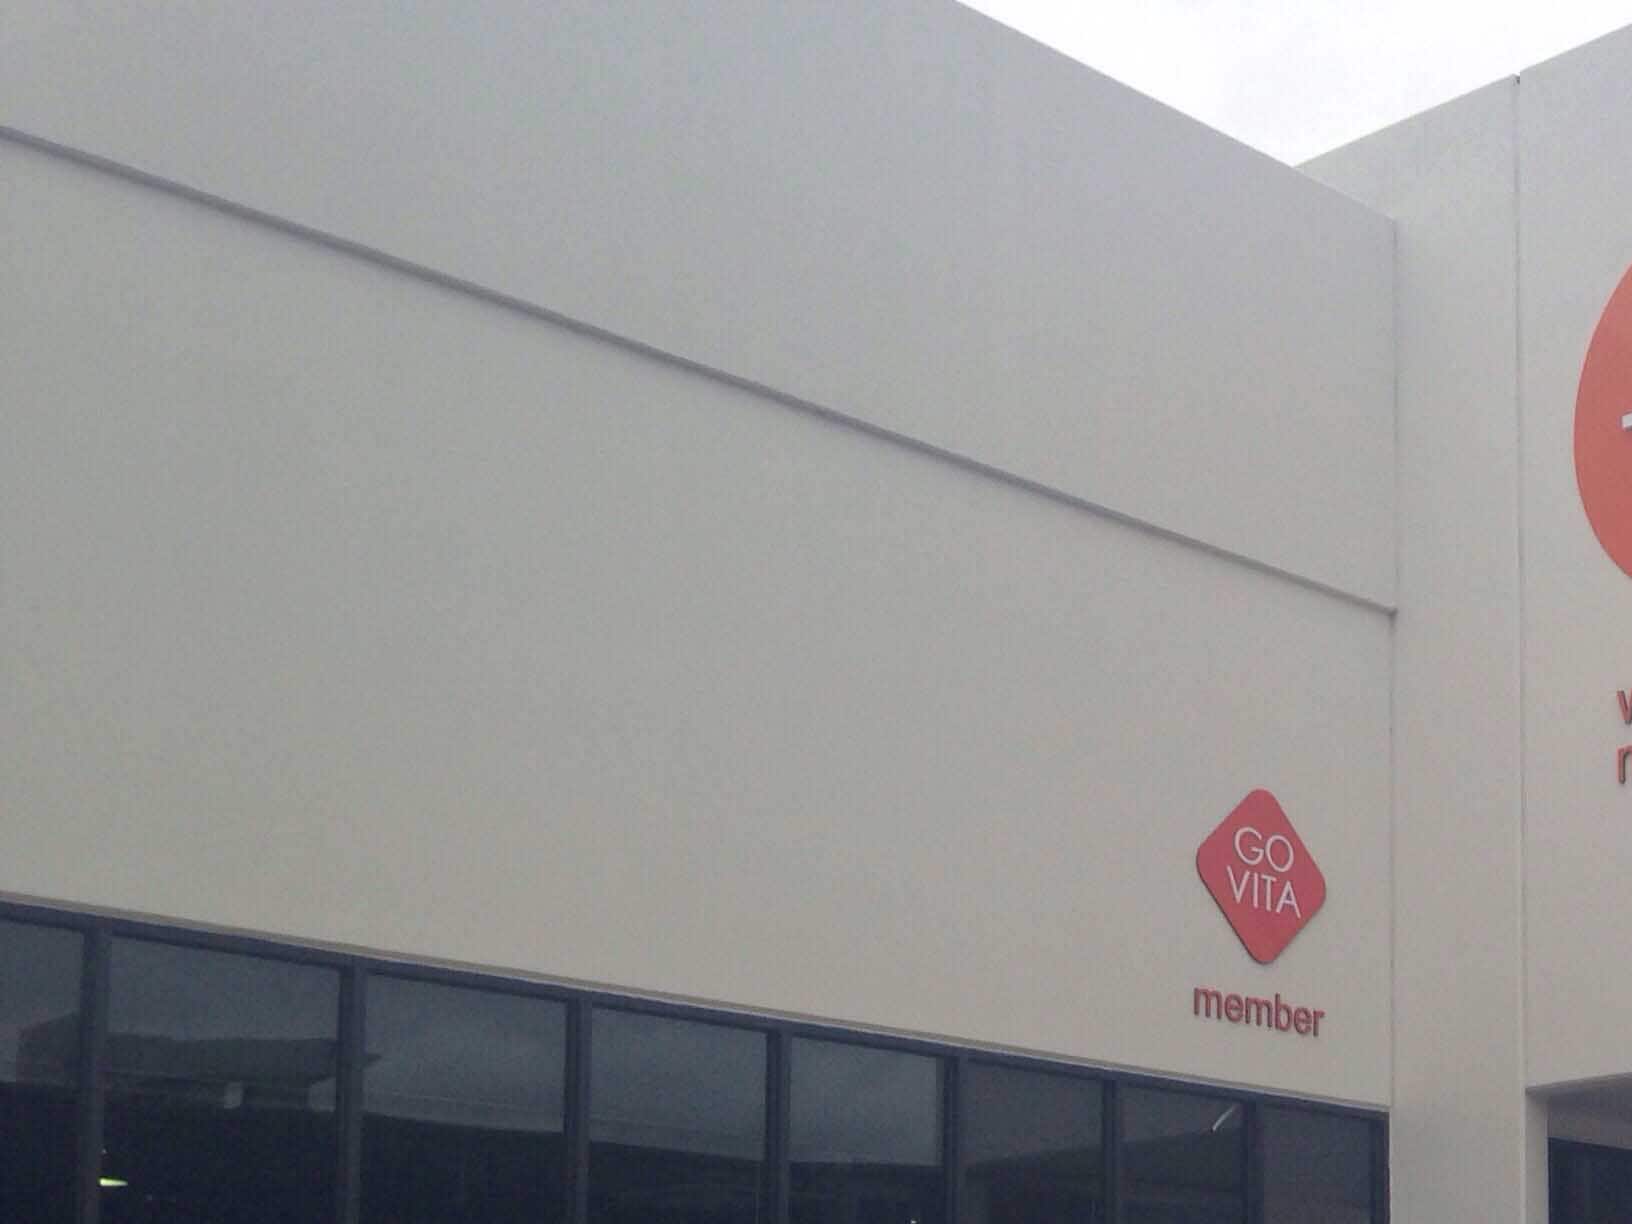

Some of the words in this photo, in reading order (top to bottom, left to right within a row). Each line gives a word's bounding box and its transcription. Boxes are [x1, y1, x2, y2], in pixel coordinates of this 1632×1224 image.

[1234, 826, 1294, 873] GO
[1226, 864, 1301, 918] VITA
[1193, 986, 1325, 1037] member
